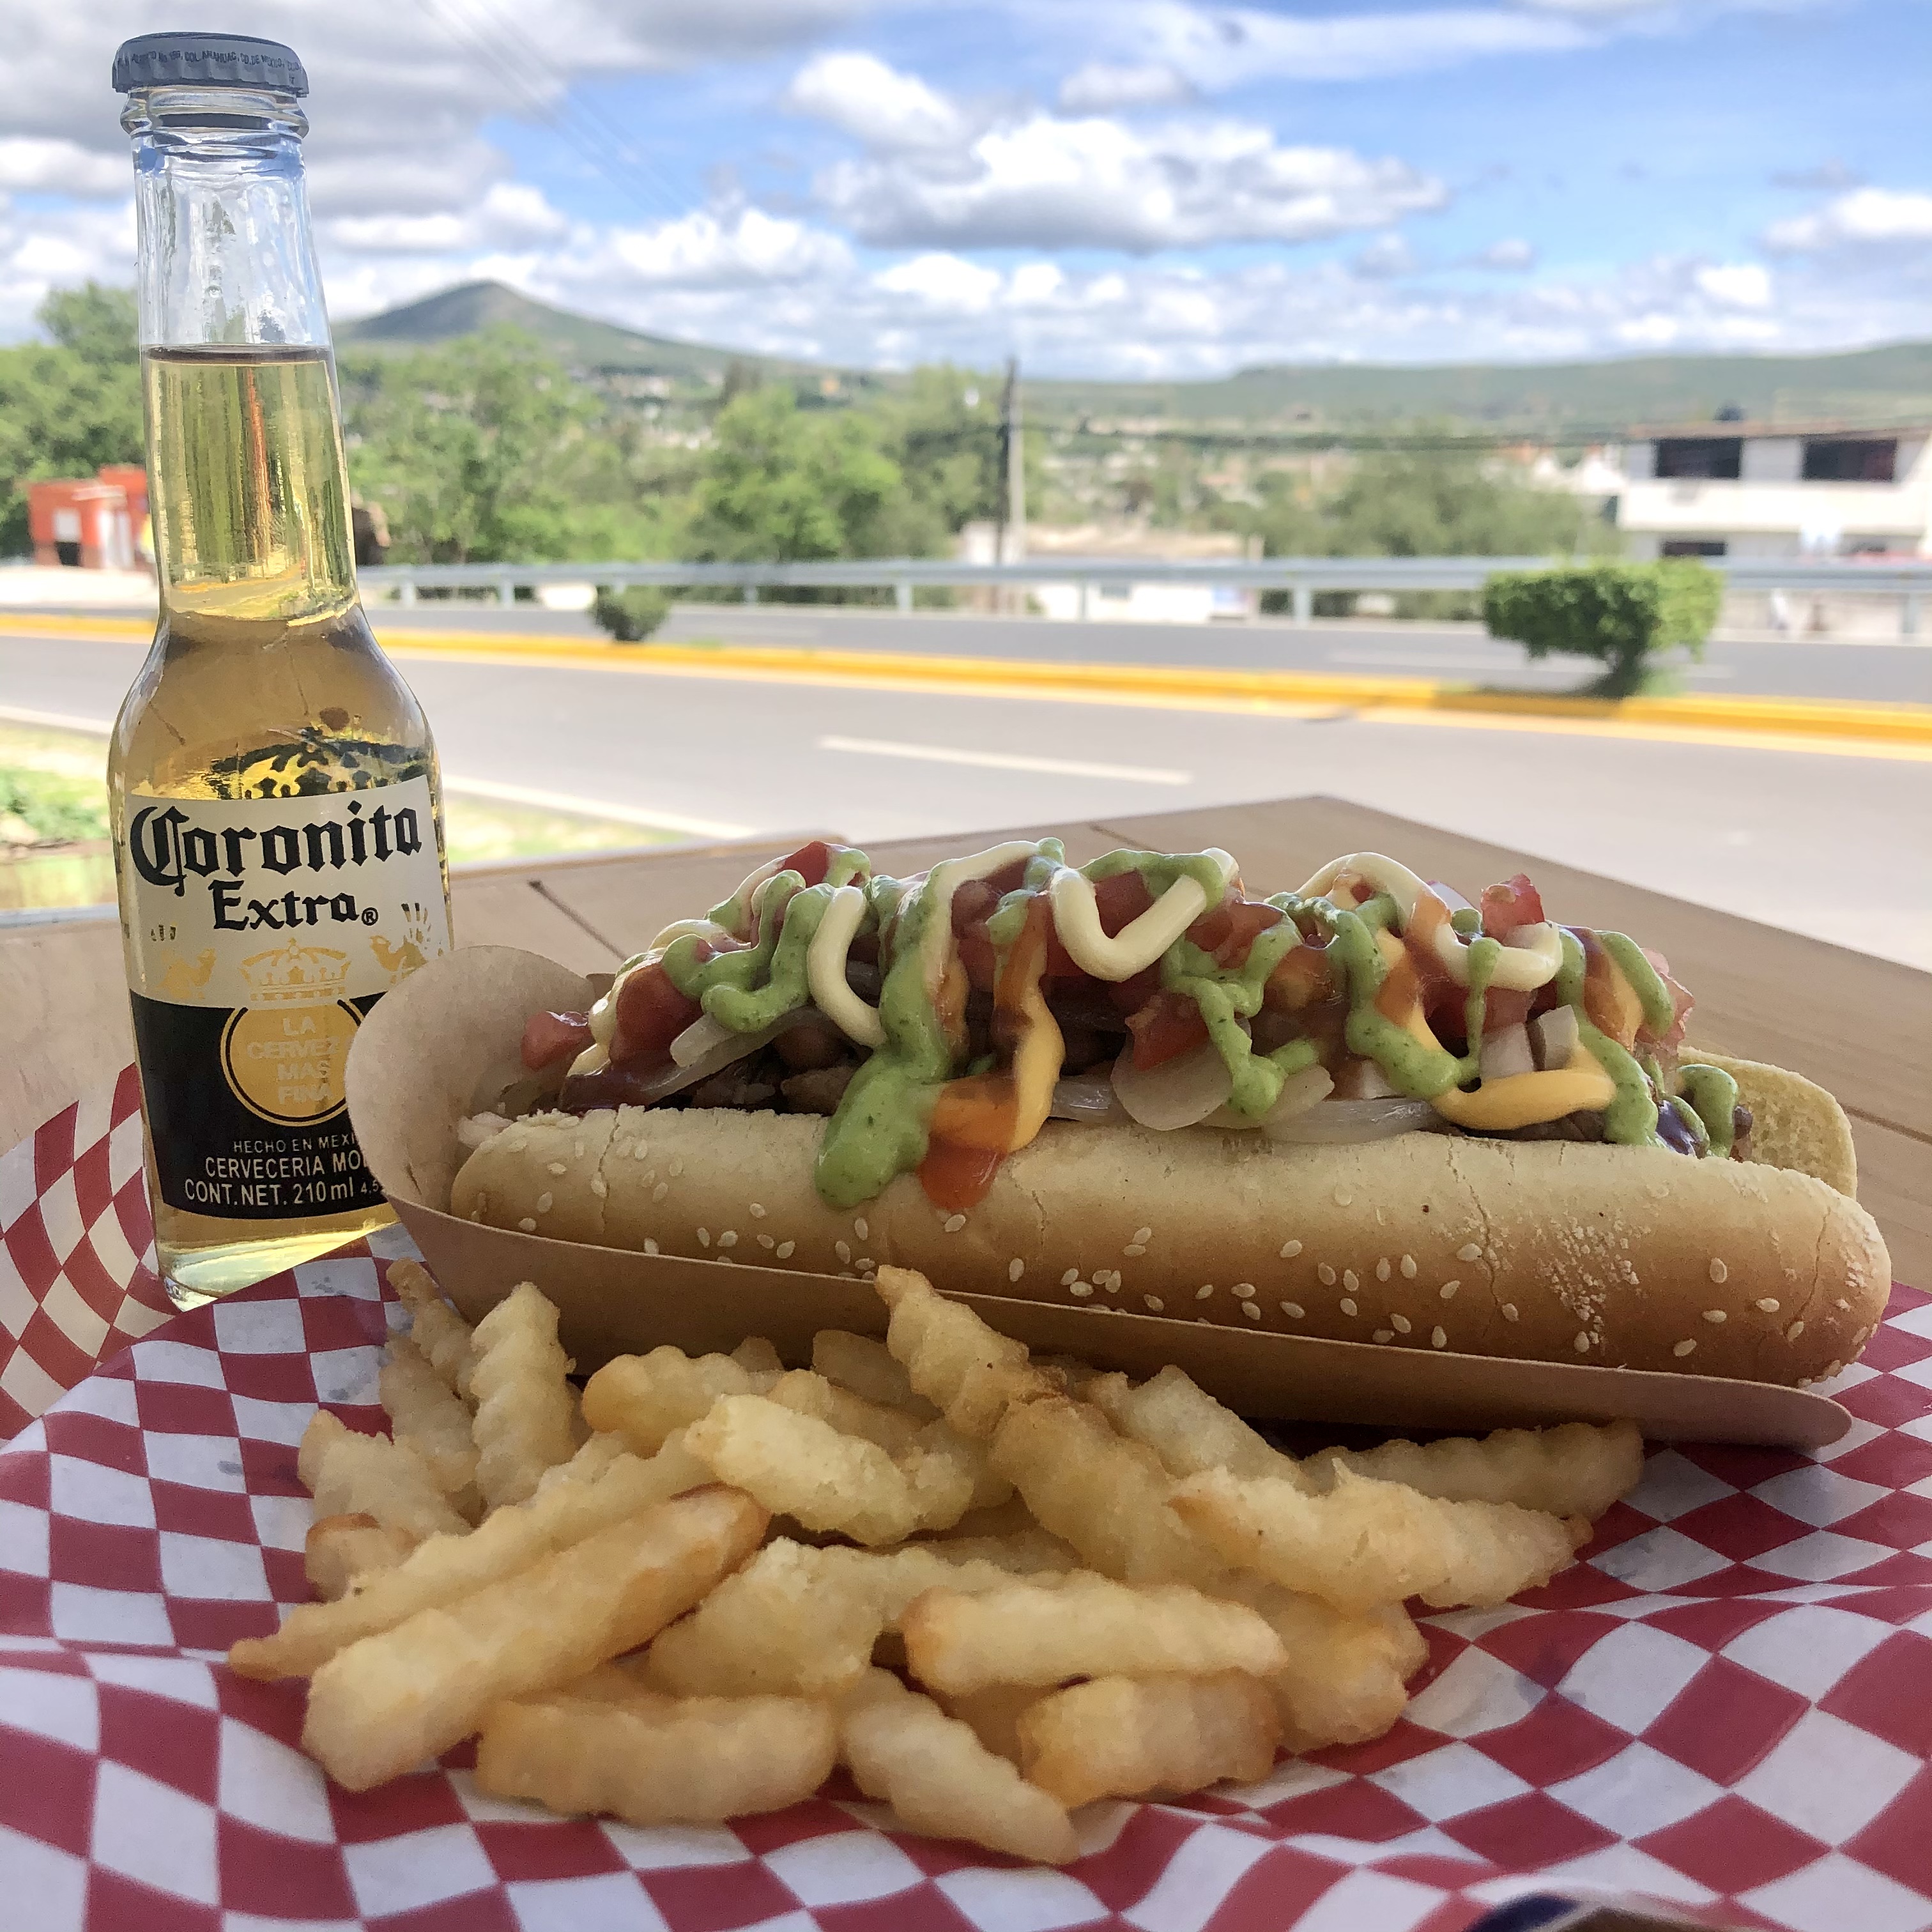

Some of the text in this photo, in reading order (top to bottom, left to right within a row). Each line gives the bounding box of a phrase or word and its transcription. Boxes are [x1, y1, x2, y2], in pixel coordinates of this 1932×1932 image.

[130, 801, 422, 896] Coronita
[282, 1016, 316, 1036] LA
[247, 1034, 353, 1059] CERVEZ
[277, 1061, 331, 1080] MAS
[278, 1082, 334, 1105] FINA
[234, 1133, 355, 1153] HECHO EN MEXI
[206, 1149, 366, 1179] CERVECERIA MO
